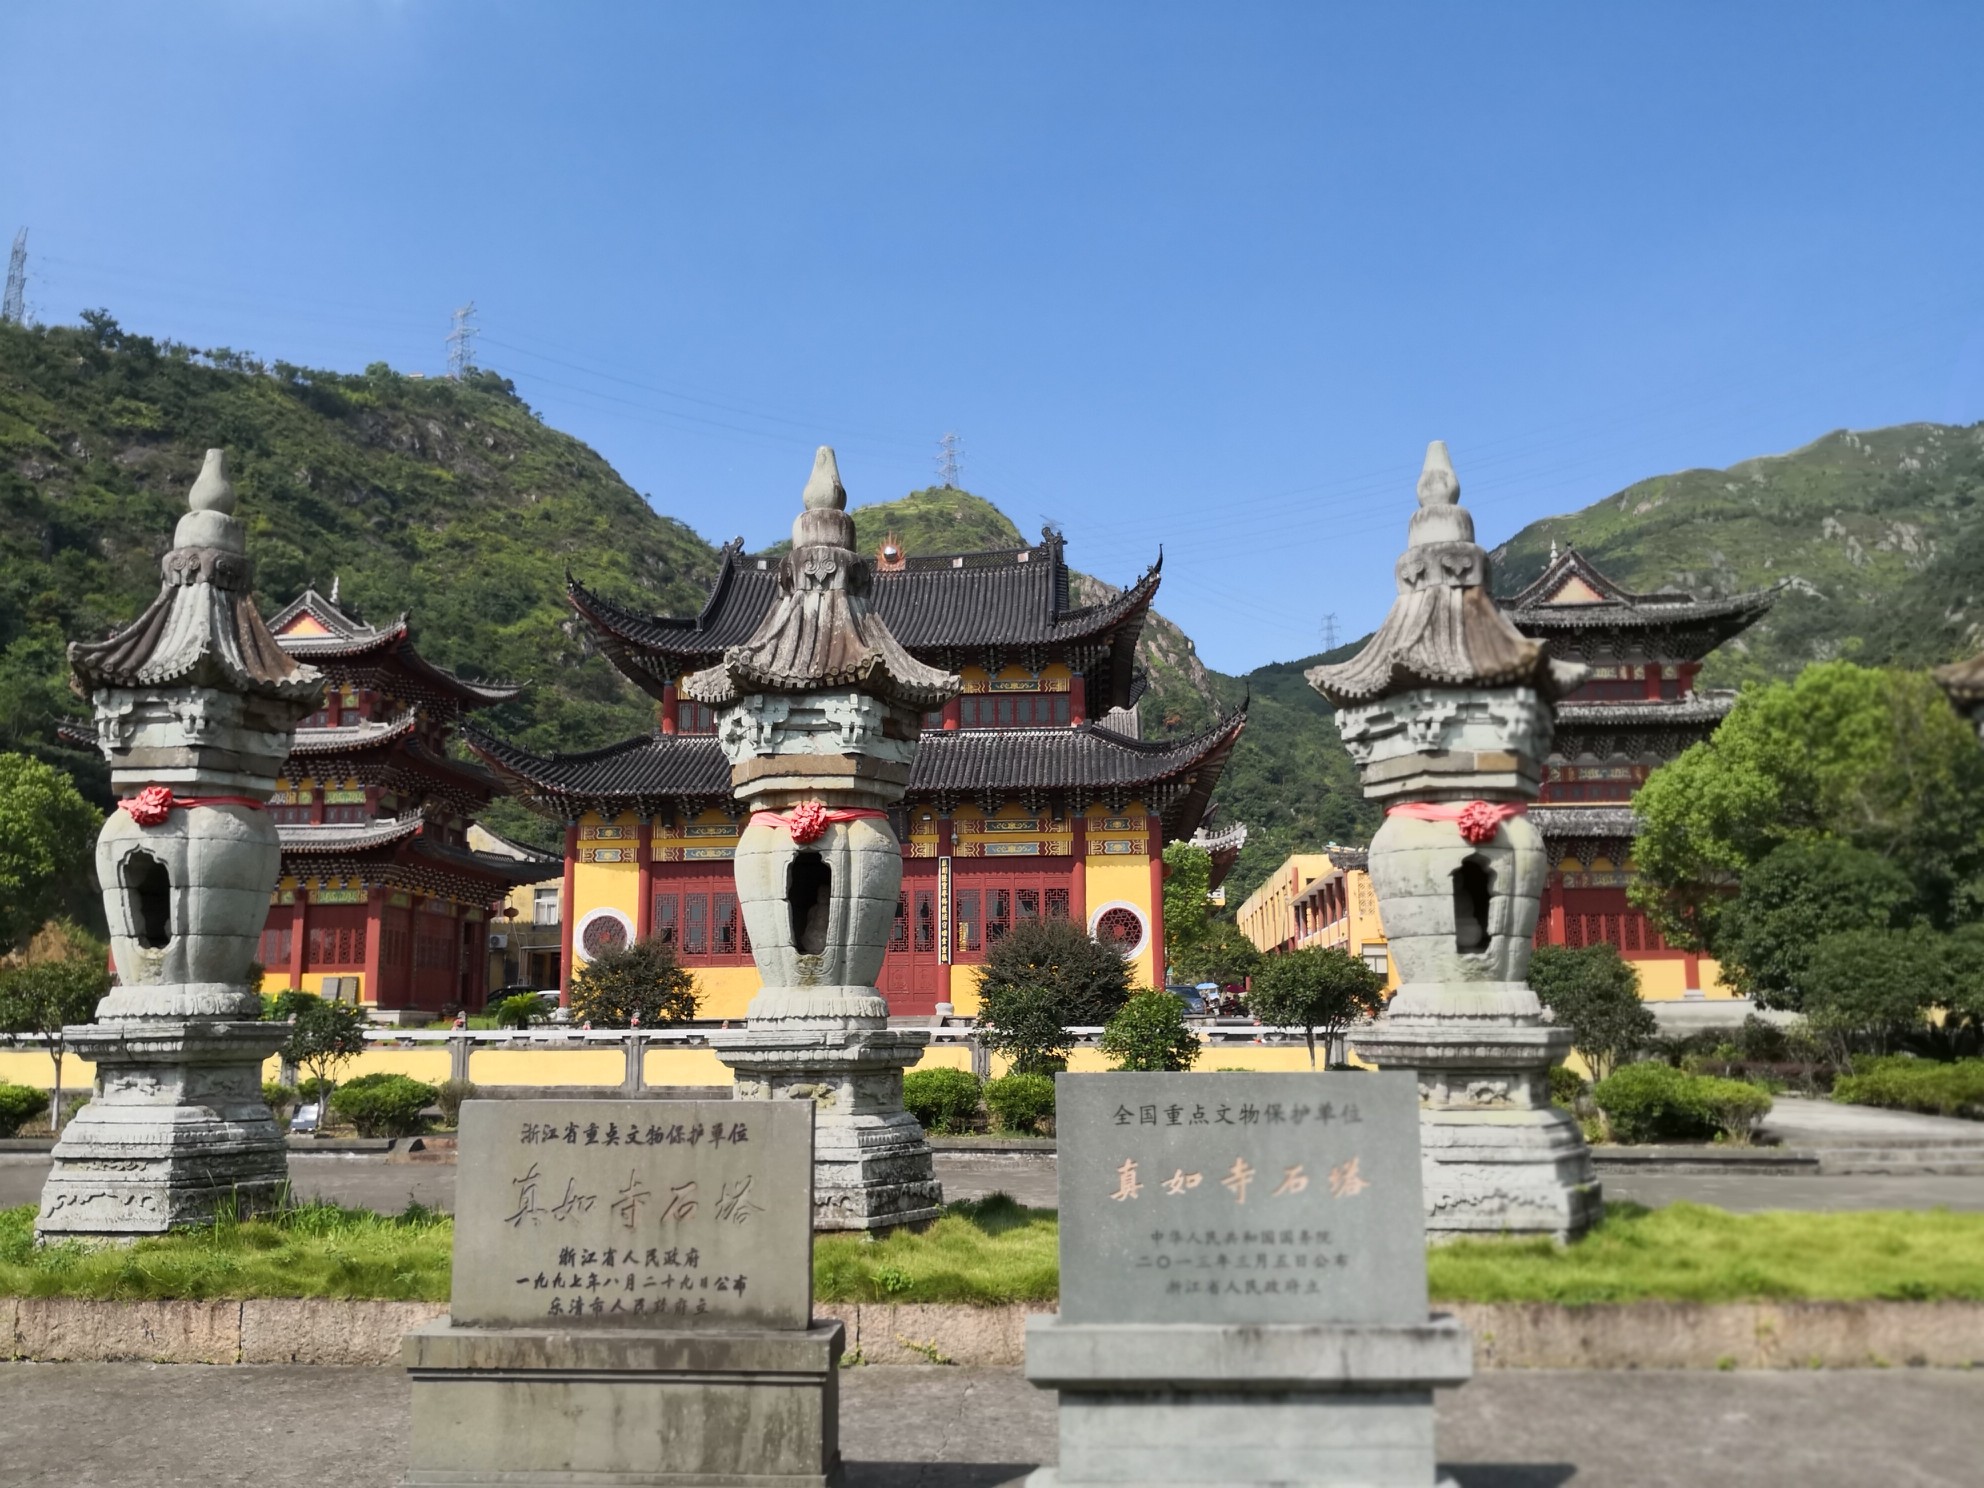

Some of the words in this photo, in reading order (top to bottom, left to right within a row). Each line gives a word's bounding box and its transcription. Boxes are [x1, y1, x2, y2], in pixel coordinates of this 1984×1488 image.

[1113, 1101, 1364, 1127] 全国重点文物保护单位
[1109, 1155, 1371, 1205] 真如寺石塔
[505, 1161, 766, 1230] 真如寺石塔
[1150, 1230, 1333, 1247] 中华人民共和国国务院
[558, 1247, 700, 1269] 浙江省人民政府
[515, 1273, 748, 1298] 一九九七年八月二十九日公布
[1165, 1279, 1322, 1297] 浙江省人民政府立
[548, 1298, 710, 1317] 乐清市人民政府立
